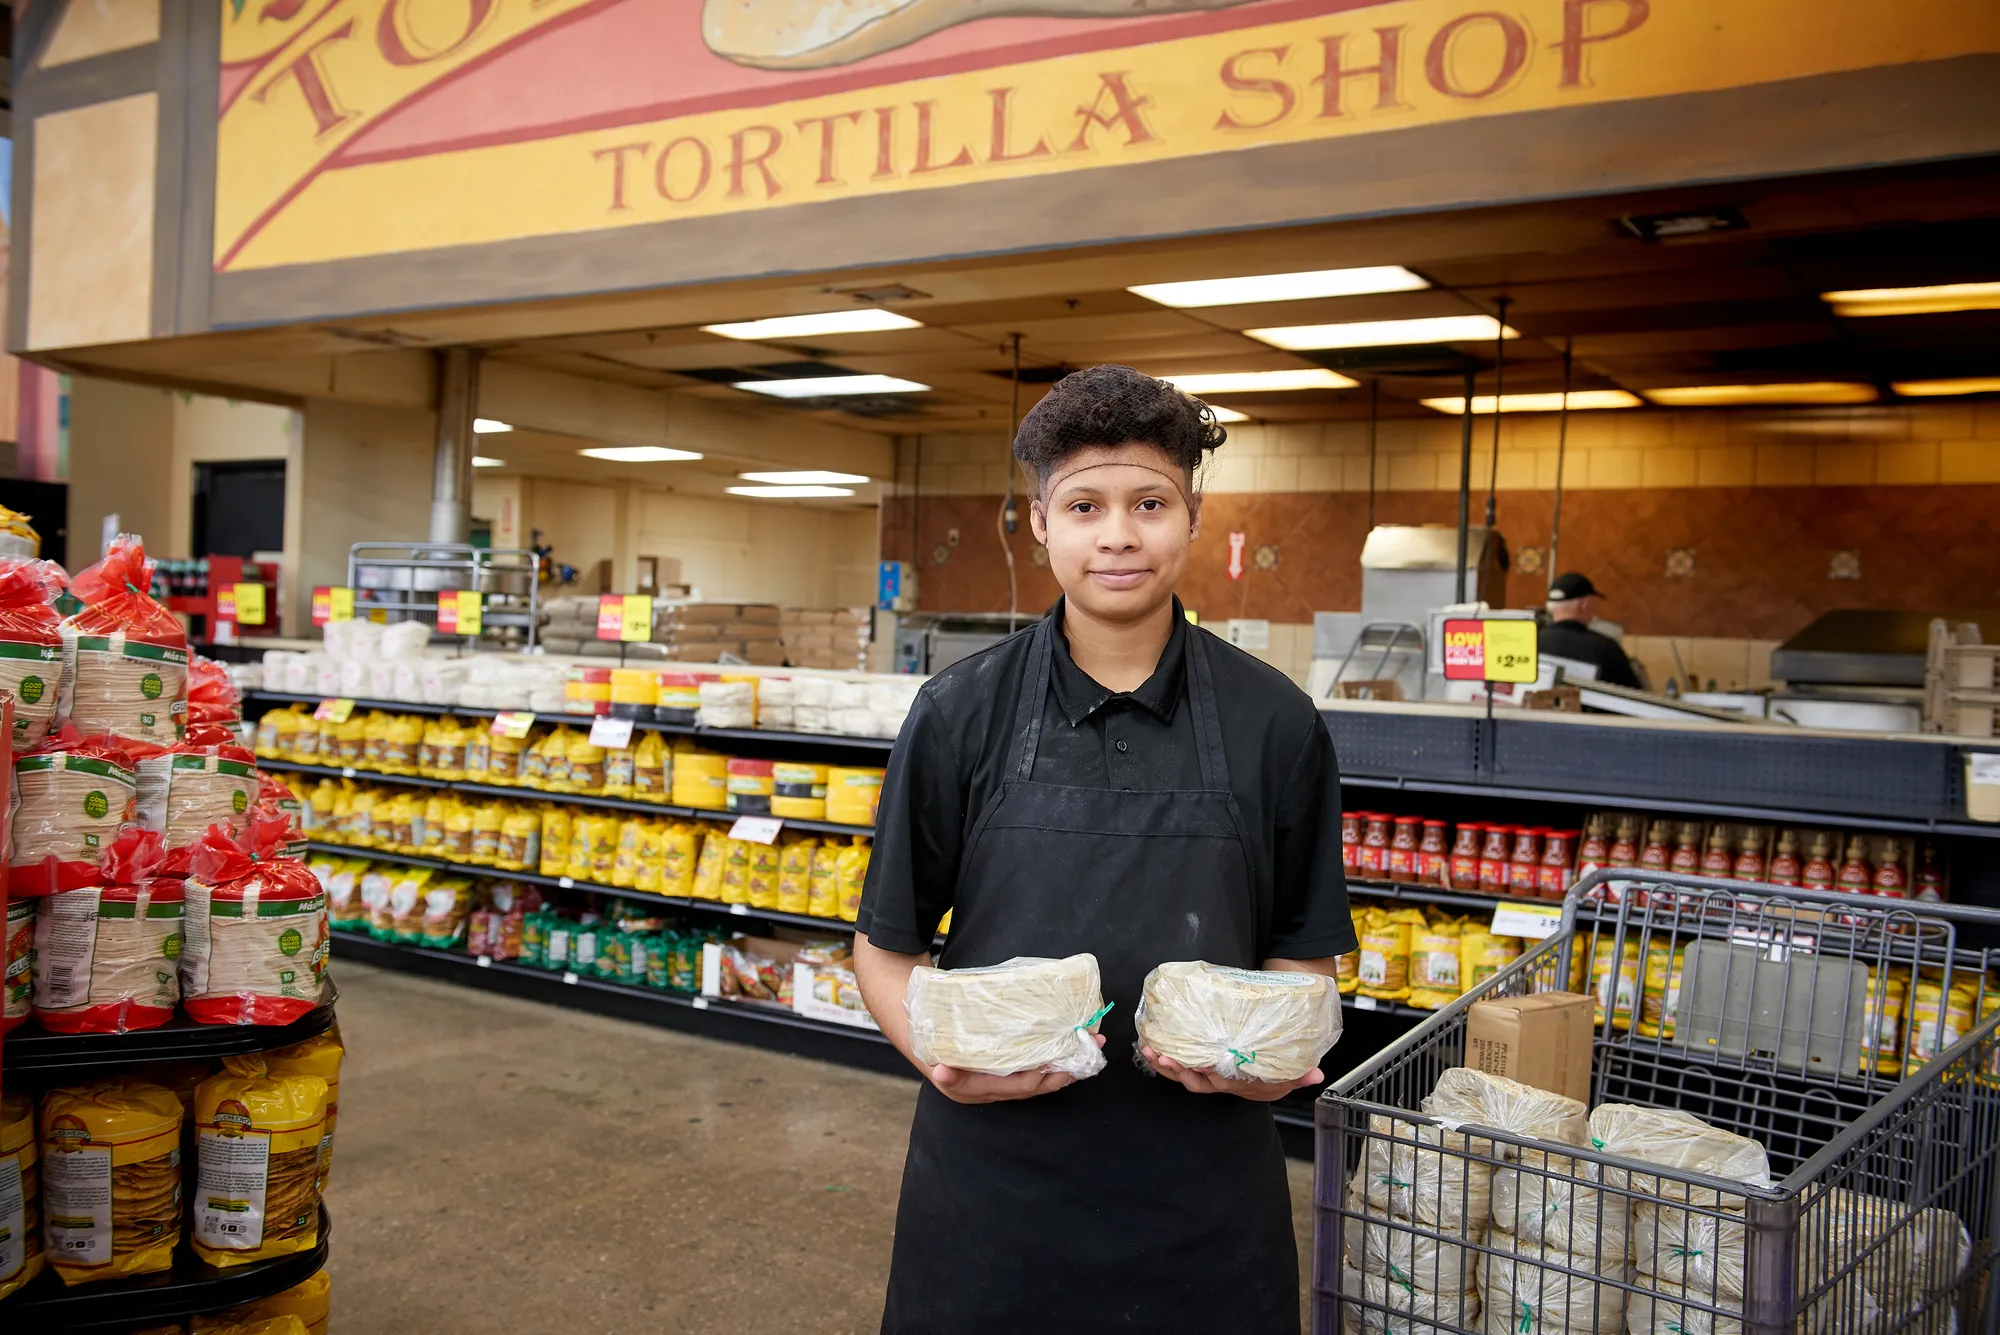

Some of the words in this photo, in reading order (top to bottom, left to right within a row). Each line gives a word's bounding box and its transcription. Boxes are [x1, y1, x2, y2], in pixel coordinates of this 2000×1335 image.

[591, 69, 1162, 212] TORTILLA
[1212, 0, 1652, 131] SHOP
[1445, 632, 1483, 647] LOW
[142, 716, 152, 724] 80
[90, 796, 106, 804] GOOD
[283, 973, 292, 981] 80
[1485, 1040, 1493, 1074] WICKETED
[214, 1114, 250, 1125] GUERRERO
